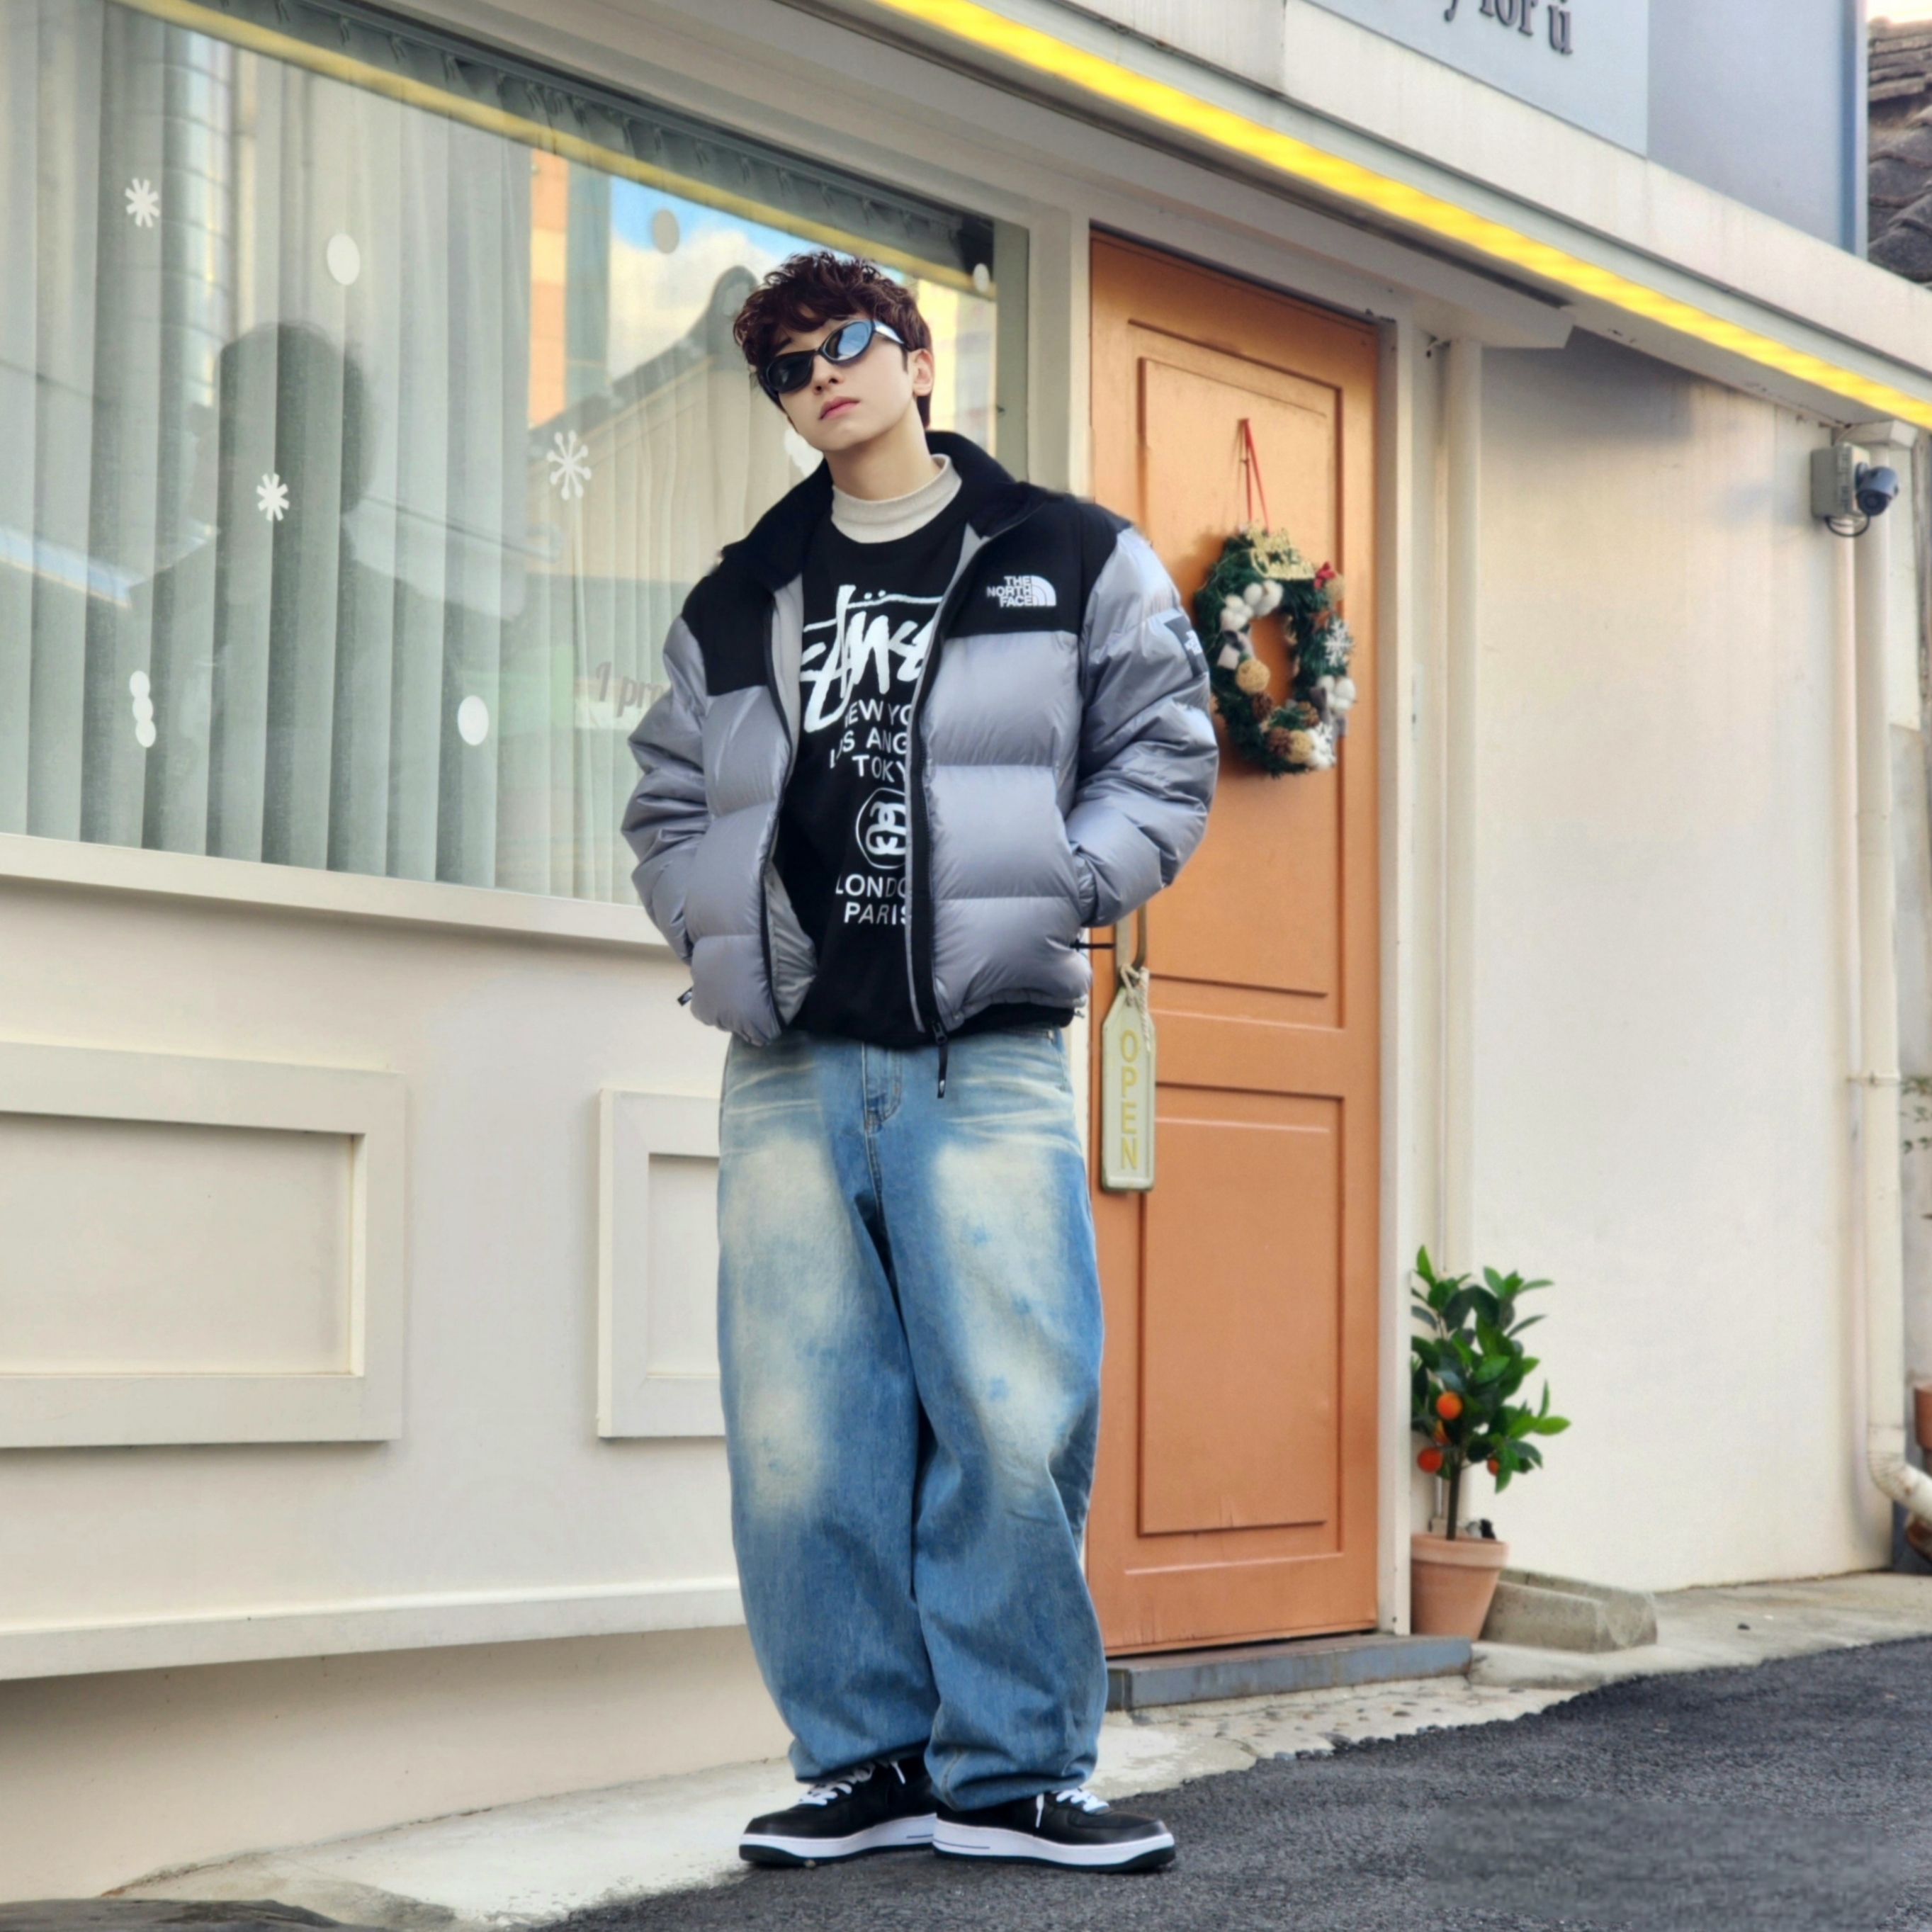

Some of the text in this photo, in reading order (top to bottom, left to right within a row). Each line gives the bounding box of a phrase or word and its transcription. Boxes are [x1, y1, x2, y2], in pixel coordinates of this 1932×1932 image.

[1004, 575, 1032, 586] THE
[986, 585, 1032, 597] NORTH
[1000, 596, 1032, 607] FACE
[1119, 1029, 1140, 1170] OPEN
